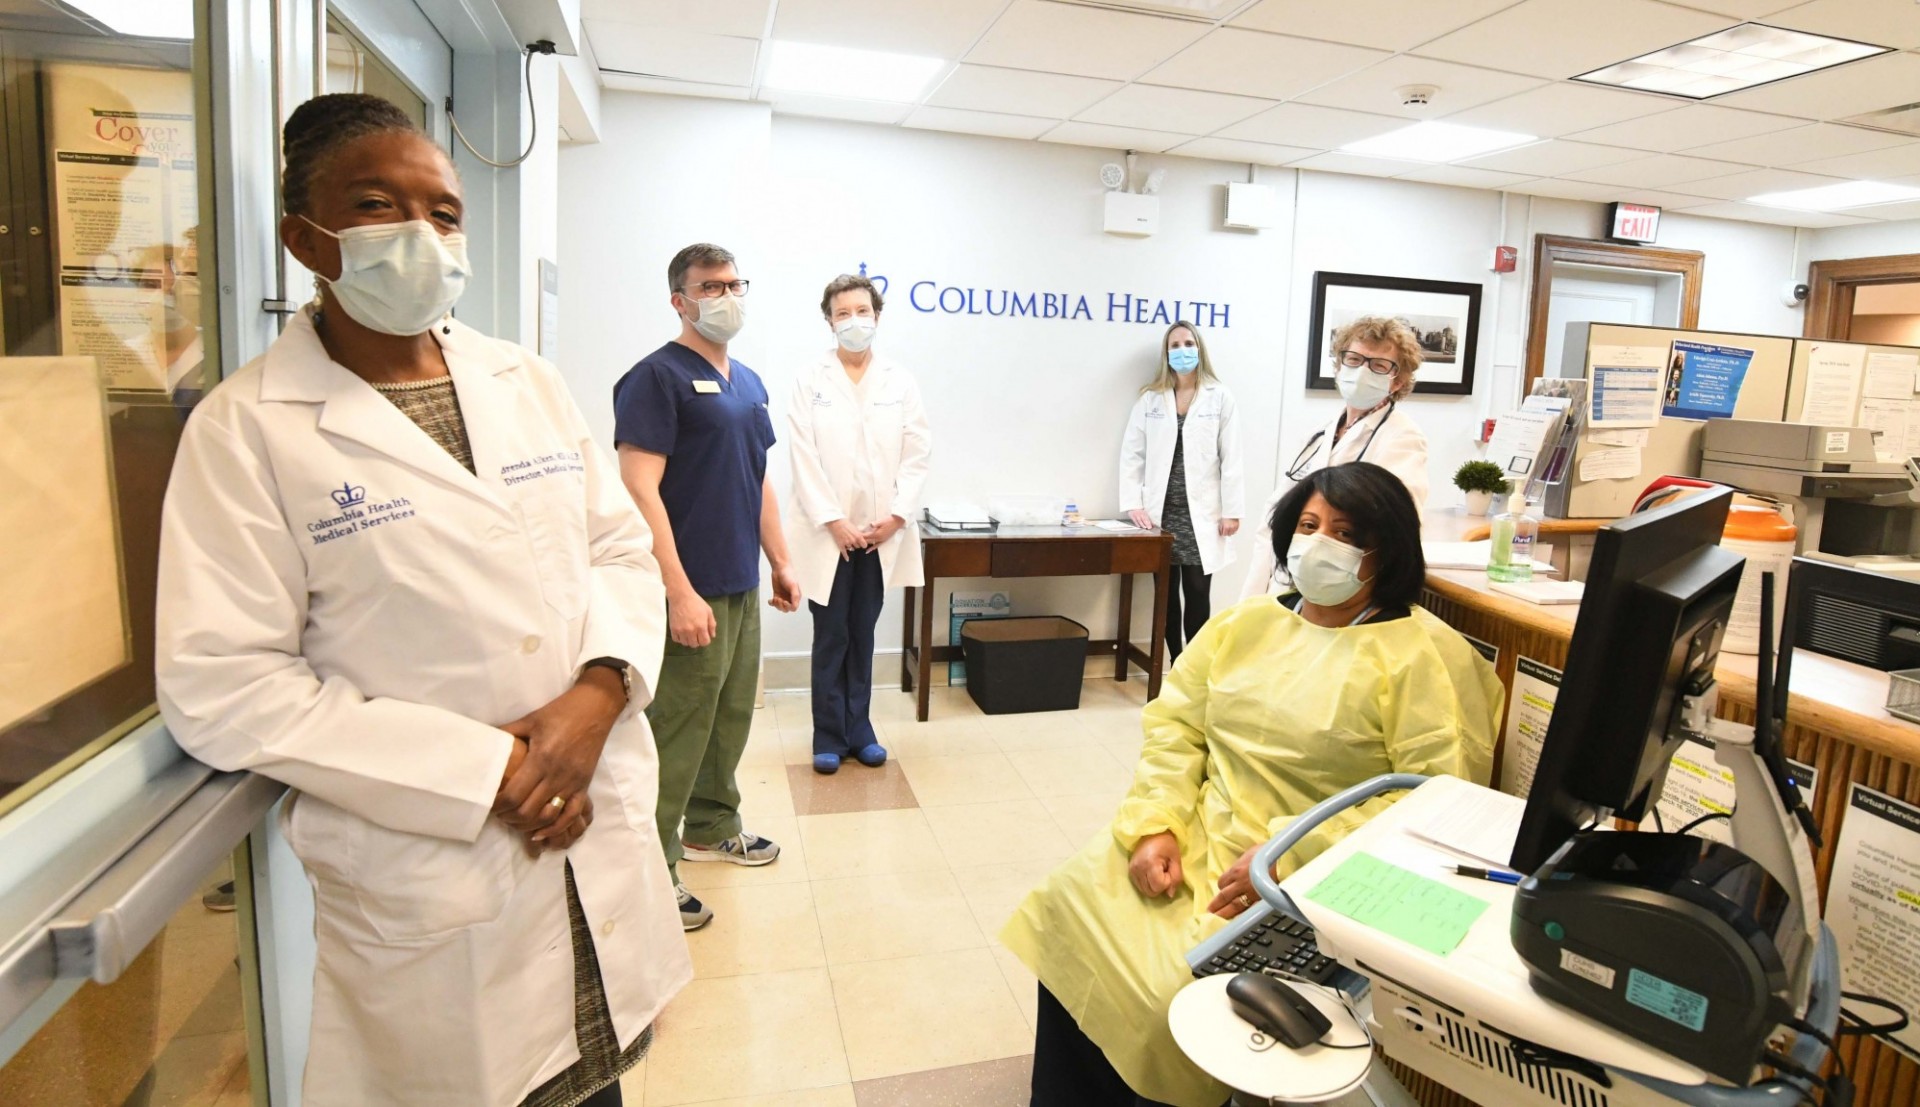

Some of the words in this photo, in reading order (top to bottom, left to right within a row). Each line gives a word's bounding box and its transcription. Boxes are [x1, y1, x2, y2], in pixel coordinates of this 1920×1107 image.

[96, 117, 178, 142] Cover
[307, 509, 364, 534] Columbia
[367, 497, 411, 515] Health
[312, 520, 359, 545] Medical
[360, 508, 416, 530] Services
[1520, 661, 1535, 672] Virtual
[1536, 668, 1553, 679] Service
[1690, 766, 1707, 778] Office
[1685, 808, 1699, 817] 2020
[1857, 793, 1885, 811] Virtual
[1886, 805, 1920, 825] Service
[1859, 840, 1895, 860] Columbia
[1851, 880, 1884, 900] virtually
[1848, 895, 1869, 909] What
